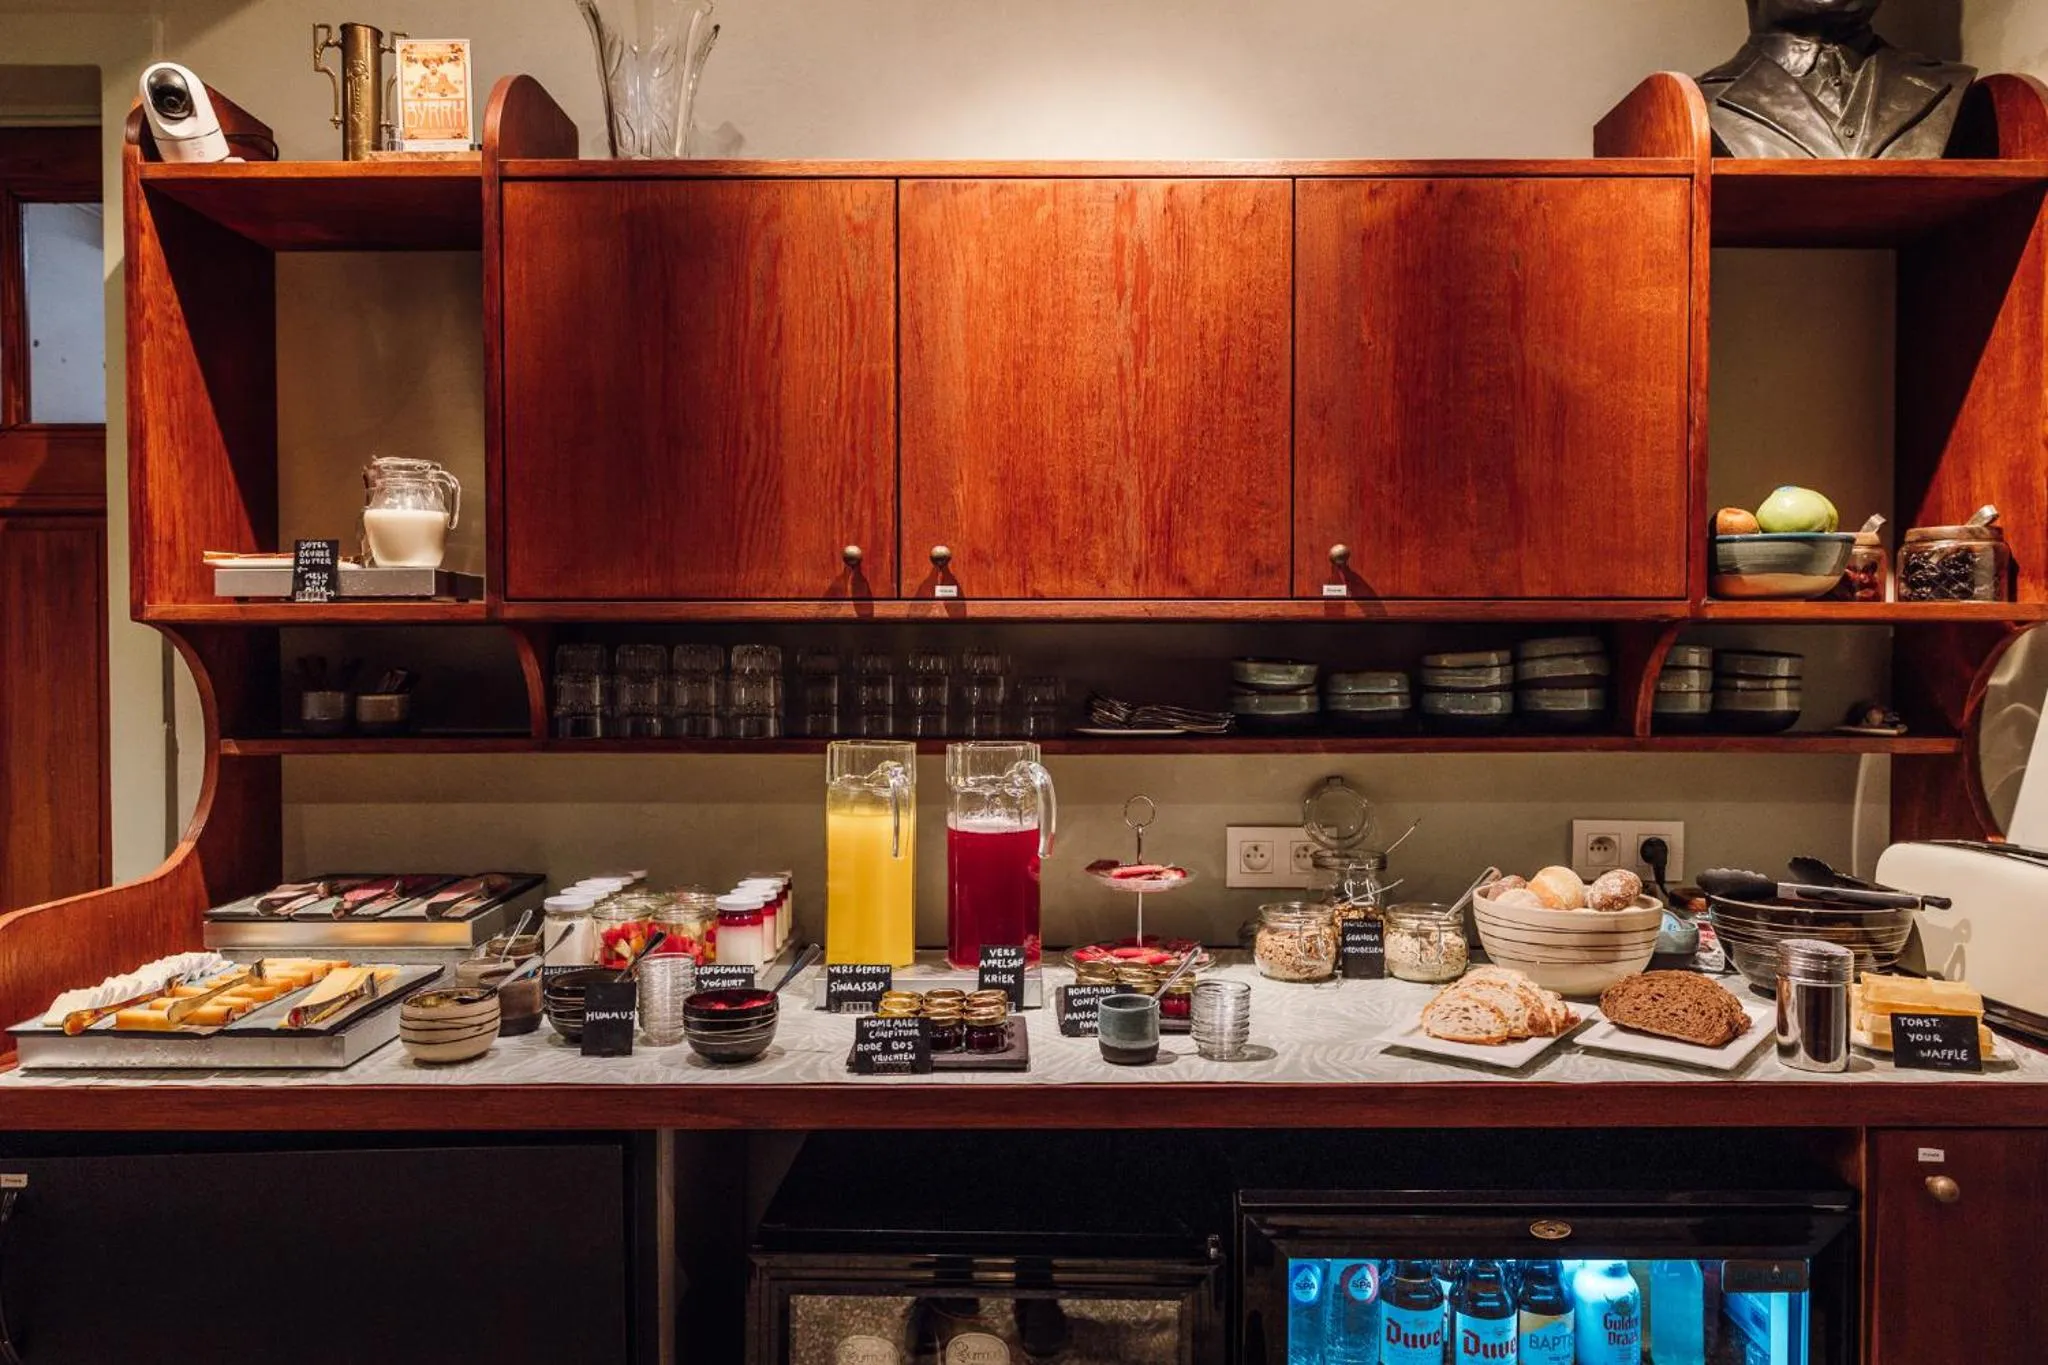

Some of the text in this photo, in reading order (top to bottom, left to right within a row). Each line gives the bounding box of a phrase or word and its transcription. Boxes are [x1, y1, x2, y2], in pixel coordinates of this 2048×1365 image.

[1346, 933, 1380, 942] GRANOLA
[989, 948, 1016, 957] VERS
[980, 957, 1024, 968] APPELSAP
[829, 965, 890, 974] VERS GEPERST
[984, 971, 1015, 984] KRIEK
[701, 979, 745, 989] YOGHURT
[1072, 995, 1099, 1007] CONFI
[586, 1011, 635, 1022] HUMMUS
[1065, 1011, 1098, 1021] MANGO
[1079, 1020, 1099, 1029] PAPA
[1898, 1016, 1939, 1028] TOAST
[1907, 1032, 1942, 1043] YOUR
[857, 1040, 914, 1052] RODE BOS
[871, 1051, 916, 1062] VRUCHTEN
[1920, 1048, 1968, 1062] WAFFLE
[1295, 1281, 1316, 1290] SPA
[1352, 1280, 1372, 1290] SPA
[1386, 1316, 1441, 1350] Duve
[1463, 1328, 1517, 1360] Duve
